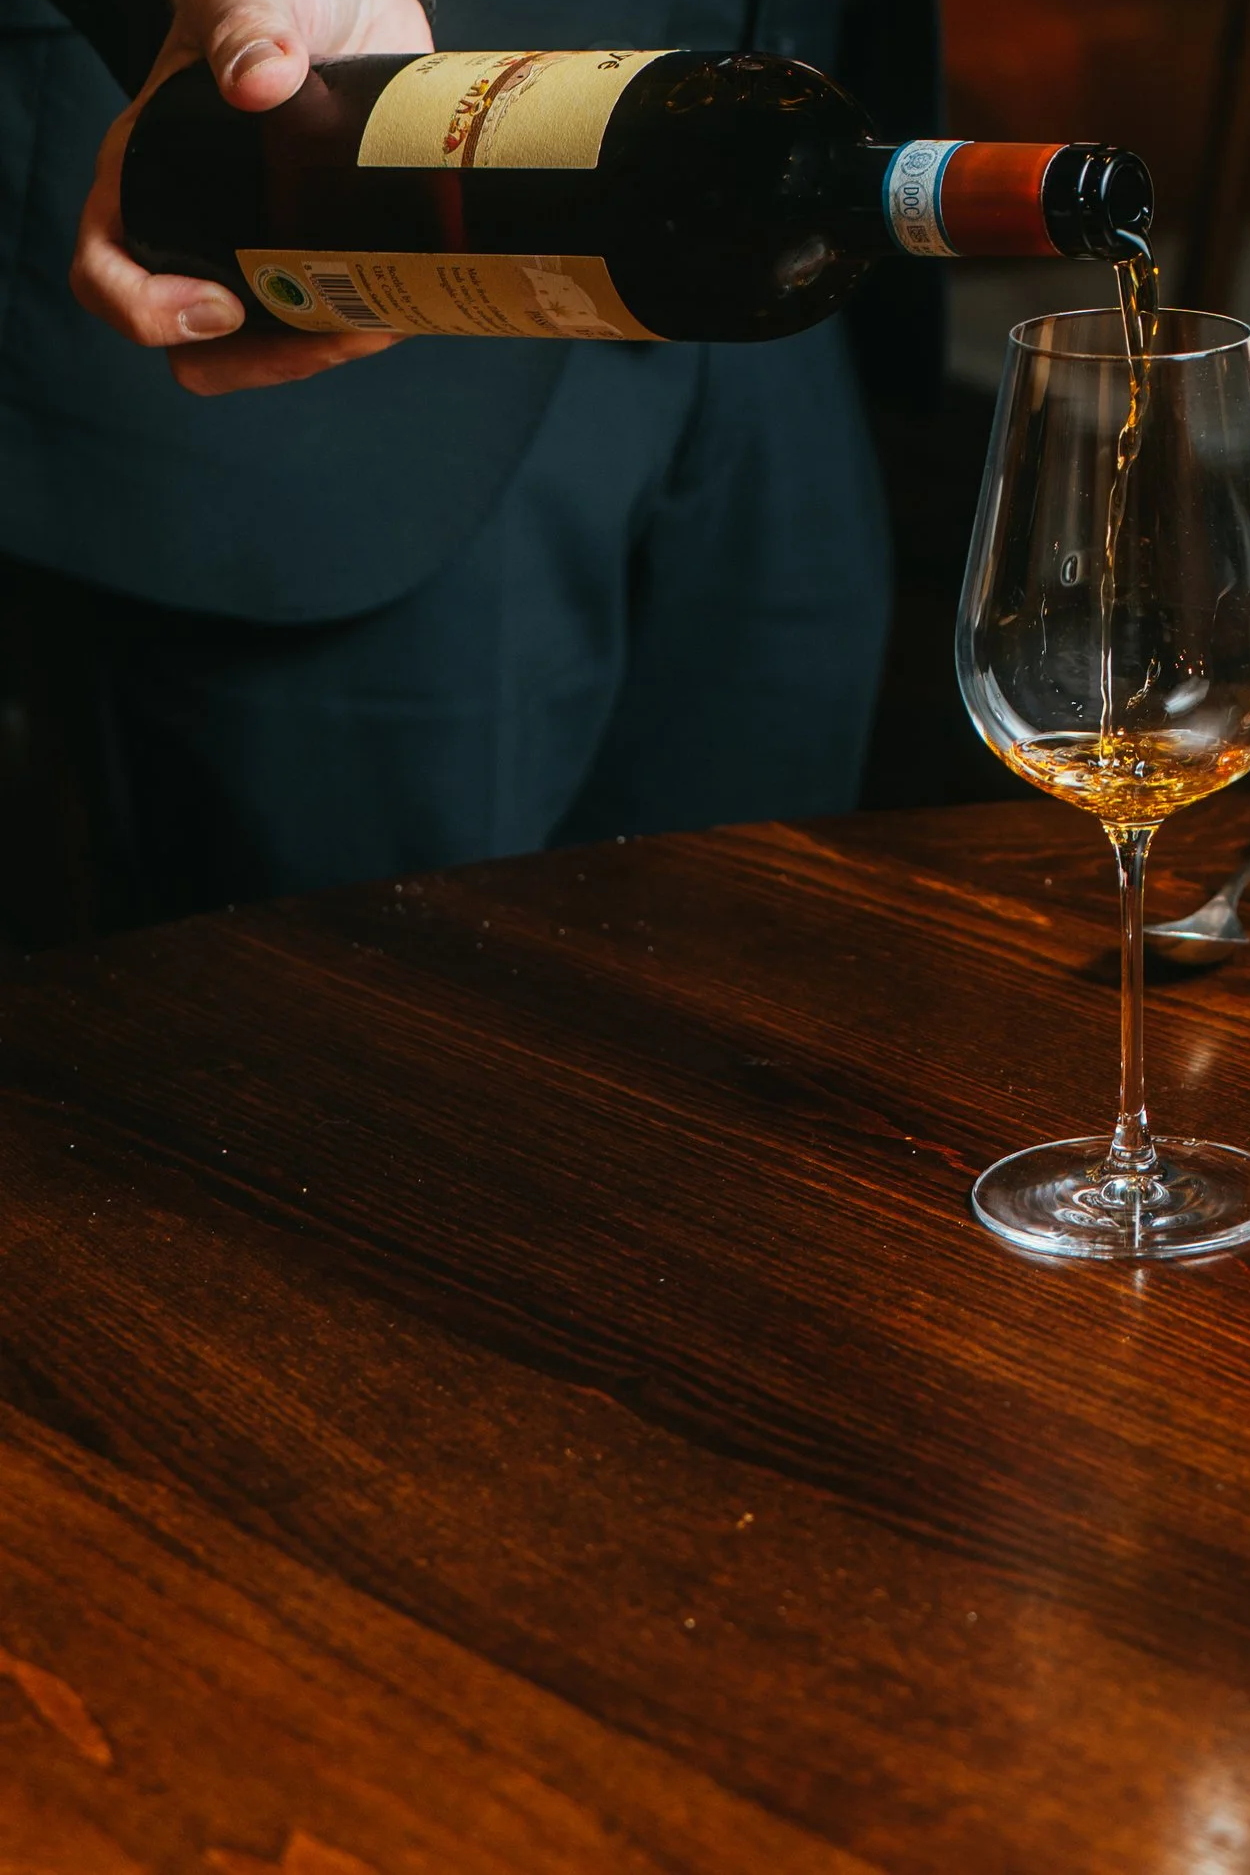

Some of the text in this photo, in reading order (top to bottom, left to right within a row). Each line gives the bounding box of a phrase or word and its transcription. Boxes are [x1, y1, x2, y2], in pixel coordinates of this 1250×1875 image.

[903, 187, 920, 215] DOC
[372, 264, 385, 282] UK
[387, 265, 408, 294] Bottled
